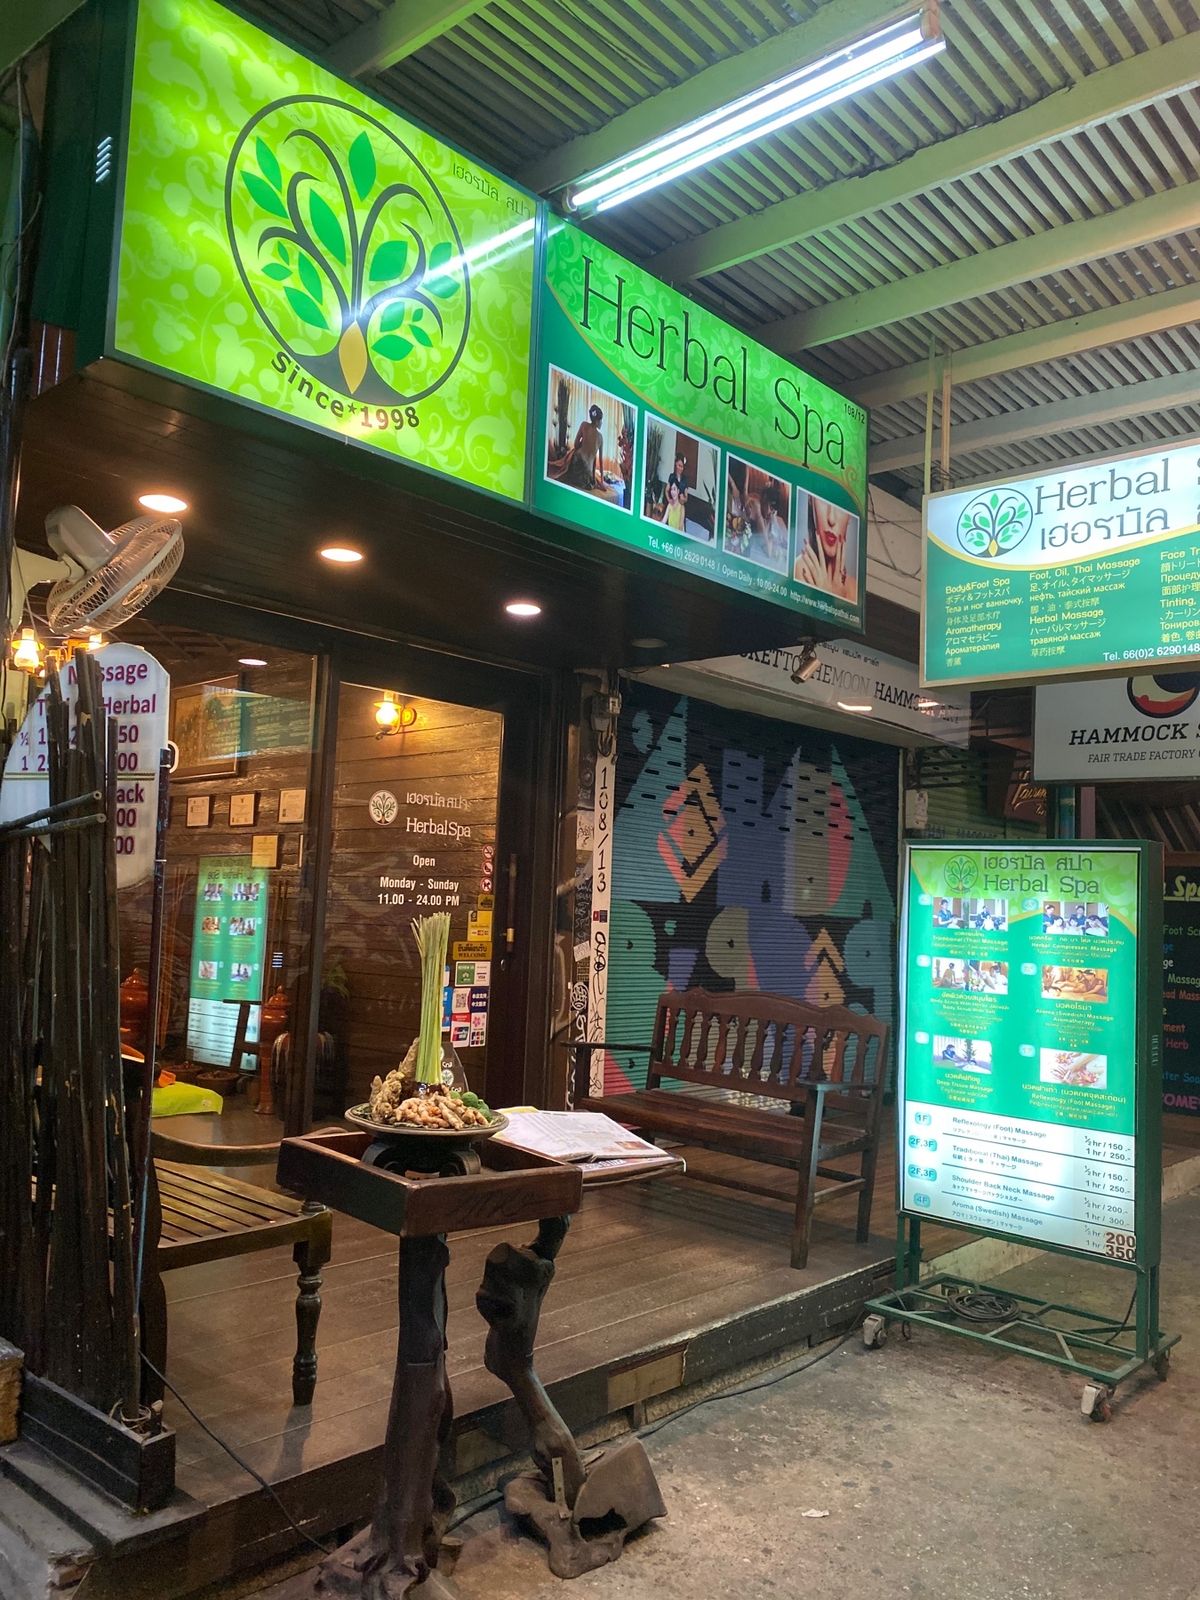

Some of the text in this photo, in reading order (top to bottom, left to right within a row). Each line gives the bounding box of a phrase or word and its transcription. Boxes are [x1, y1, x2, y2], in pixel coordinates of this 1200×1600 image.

[580, 255, 845, 469] Herbal Spa
[271, 351, 420, 430] Since 1998
[843, 403, 866, 425] 108/12
[1035, 457, 1171, 515] Herbal
[648, 535, 660, 549] Tel.
[661, 542, 674, 554] +66
[674, 546, 684, 560] (0)
[684, 550, 700, 564] 2629
[700, 557, 716, 570] 0148
[722, 564, 738, 579] Open
[739, 570, 753, 586] Daily
[1161, 550, 1186, 561] Face
[1029, 558, 1141, 582] Foot, Oil, Thai Massage
[1161, 571, 1200, 584] Процеду
[945, 577, 1011, 594] Body&Foot Spa
[1058, 585, 1091, 598] тайский
[1093, 582, 1126, 593] массаж
[1029, 609, 1105, 624] Herbal Massage
[1160, 618, 1200, 631] Тониров
[945, 621, 1002, 636] Aromatherapy
[1070, 630, 1102, 641] массаж
[945, 642, 1000, 656] Ароматерапия
[1103, 651, 1121, 661] Tel.
[1123, 648, 1155, 660] 66(0)2
[68, 663, 149, 685] Mssage
[118, 724, 139, 744] 50
[1068, 722, 1189, 746] HAMMOCK
[117, 752, 139, 771] 00
[1087, 749, 1197, 763] FAIR TRADE FACTORY
[116, 783, 145, 803] ack
[116, 808, 137, 827] 00
[115, 836, 135, 854] 00
[413, 854, 436, 868] Open
[1056, 854, 1093, 871] สปา
[380, 876, 460, 893] Monday Sunday
[983, 873, 1100, 899] Herbal Spa
[377, 893, 460, 906] 11.00 24.00 PM
[1162, 924, 1184, 936] Foot
[1167, 973, 1200, 989] Massag
[917, 1114, 929, 1122] 1F
[1014, 1127, 1047, 1139] Massage
[1092, 1140, 1102, 1148] hr
[1011, 1155, 1043, 1167] Massage
[952, 1174, 1055, 1201] Shoulder Back Neck Massage
[1092, 1181, 1101, 1189] hr
[951, 1200, 1043, 1226] Aroma (Swedish) Massage
[1106, 1232, 1137, 1248] 200
[1106, 1244, 1137, 1261] 350
